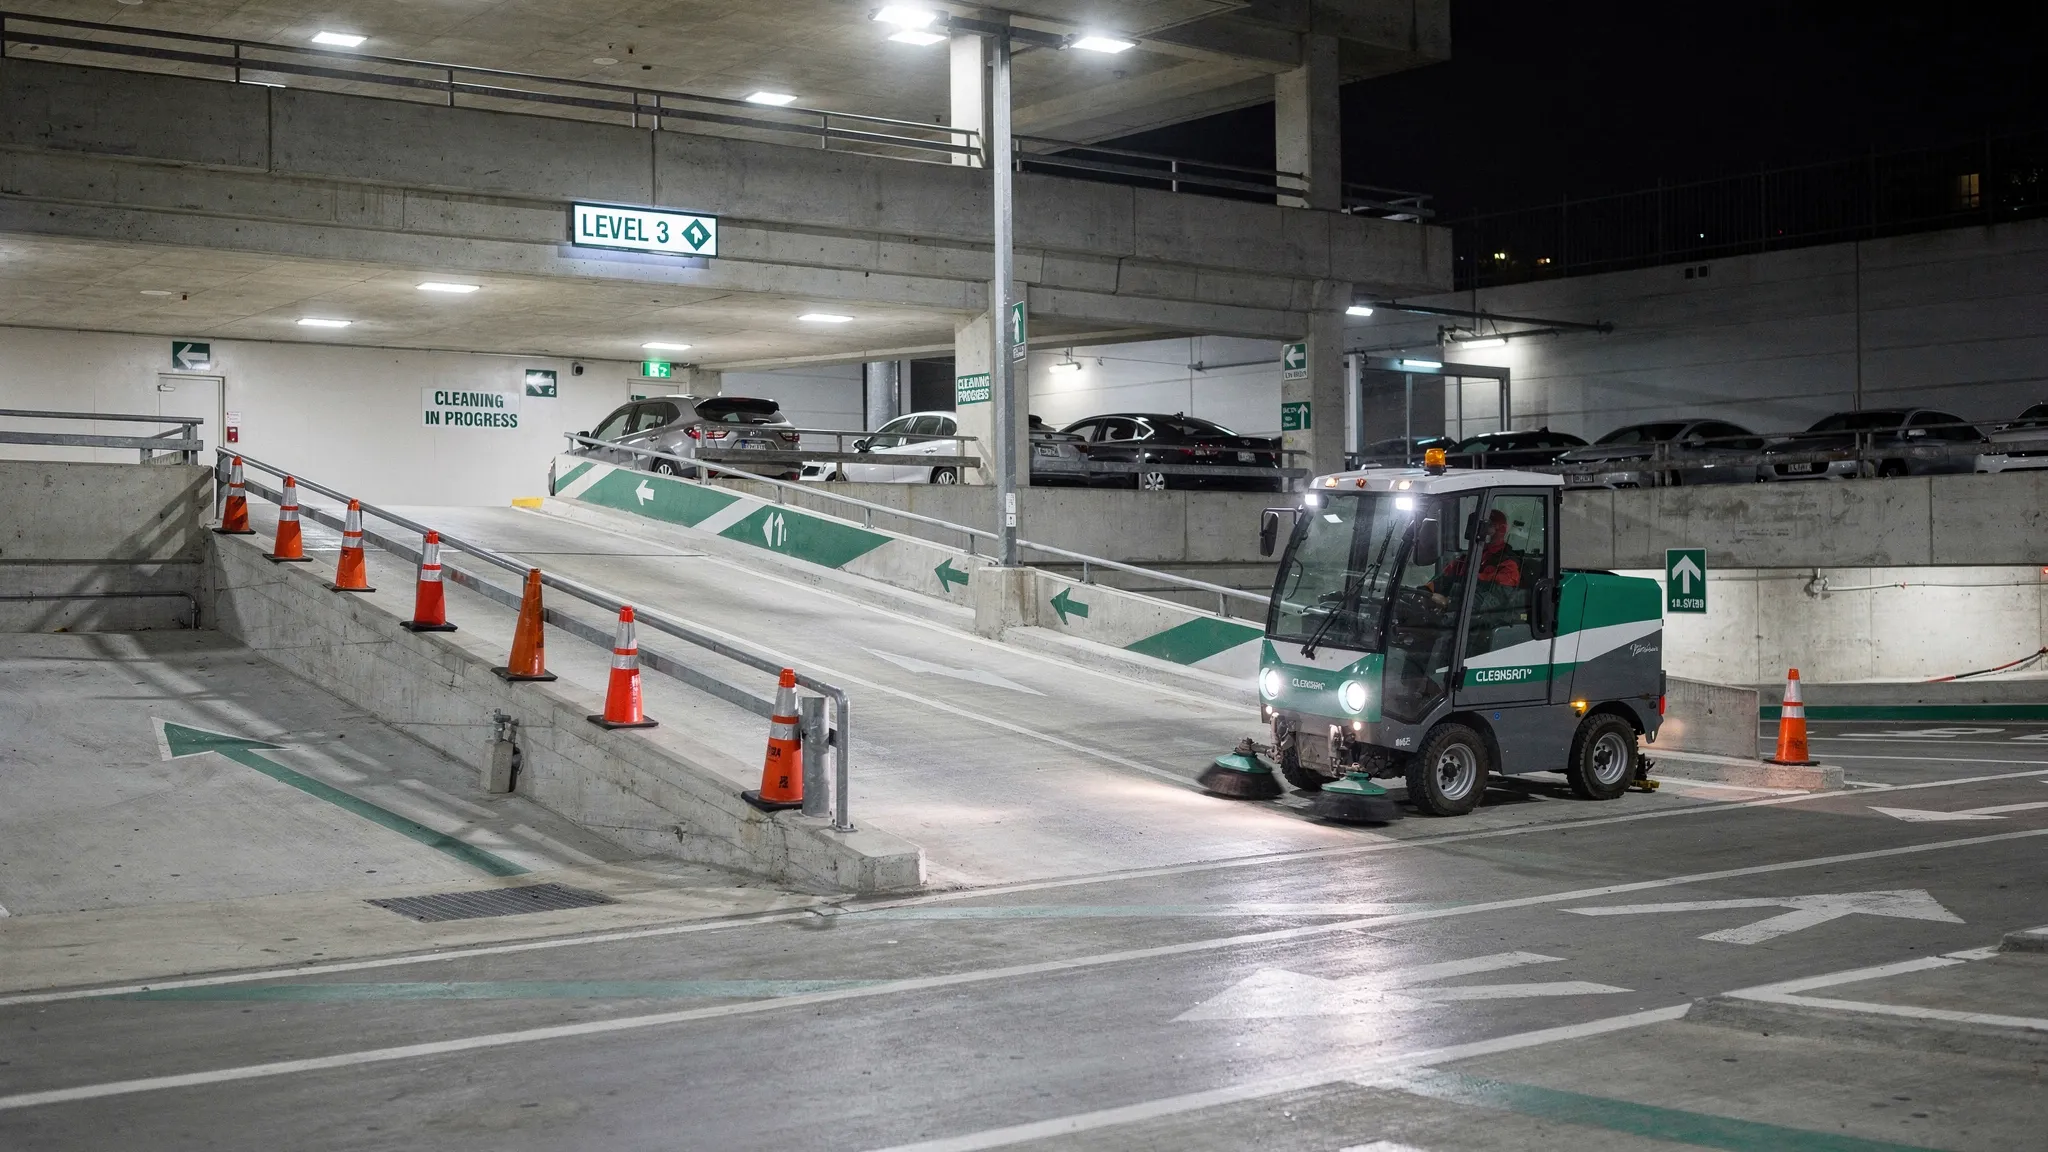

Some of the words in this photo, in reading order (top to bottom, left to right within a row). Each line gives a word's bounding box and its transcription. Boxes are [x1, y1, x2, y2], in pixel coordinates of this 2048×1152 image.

[582, 213, 649, 242] LEVEL
[656, 220, 670, 244] 3
[434, 390, 504, 409] CLEANING
[425, 410, 440, 425] IN
[445, 411, 518, 429] PROGRESS
